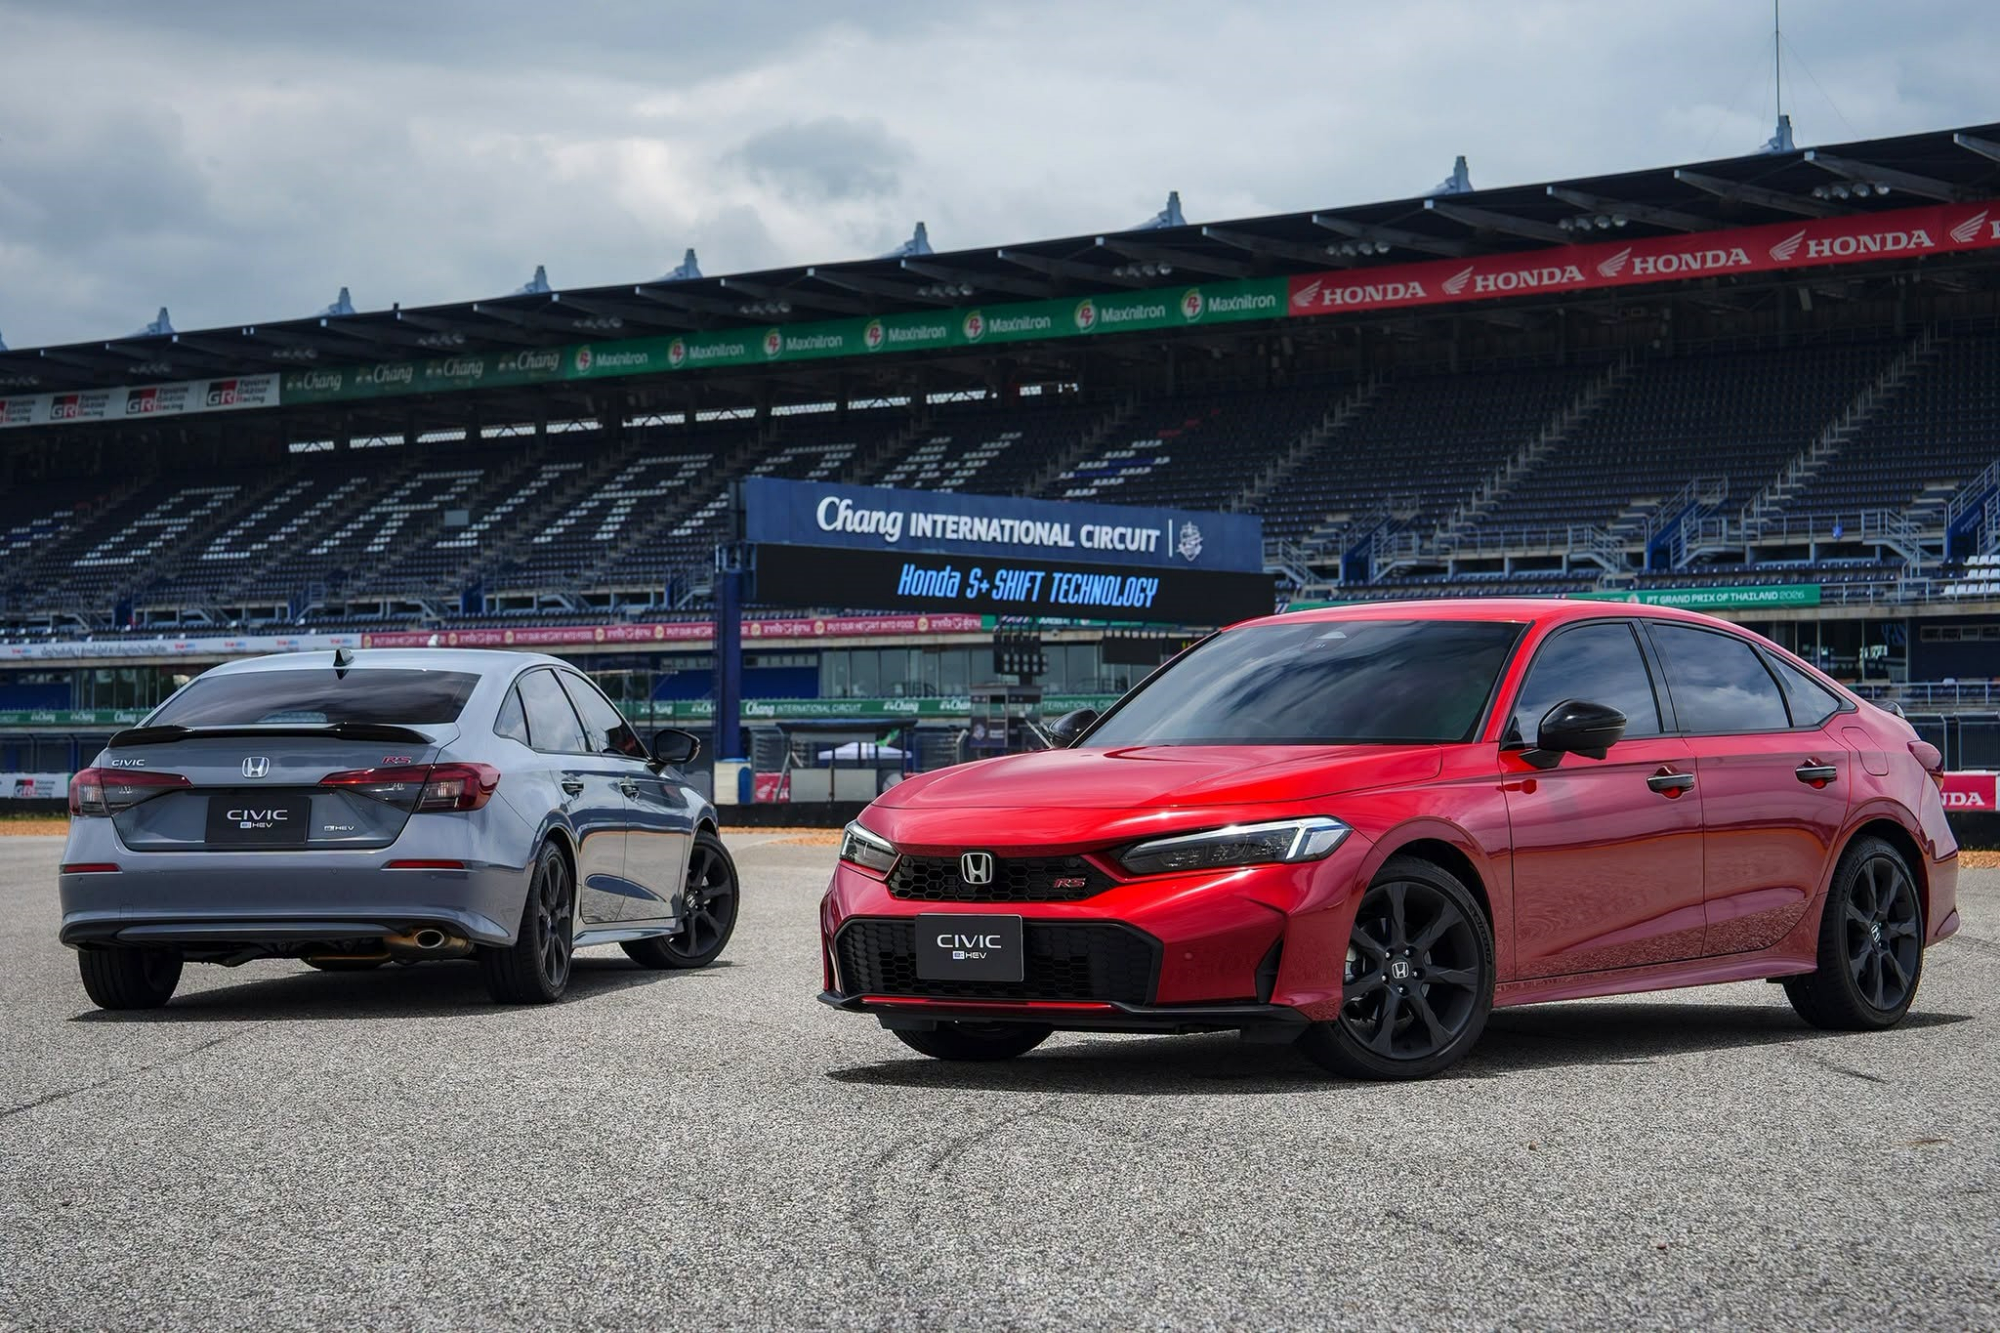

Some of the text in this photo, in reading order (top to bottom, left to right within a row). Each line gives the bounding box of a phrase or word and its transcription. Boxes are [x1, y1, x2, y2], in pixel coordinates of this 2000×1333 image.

[1806, 229, 1935, 258] HONDA
[1632, 247, 1751, 276] HONDA
[1474, 264, 1585, 293] HONDA
[1208, 293, 1275, 312] Maxnitron
[1321, 281, 1427, 305] HONDA
[1102, 304, 1165, 323] Maxnitron
[888, 326, 946, 342] Maxnitron
[989, 316, 1051, 333] Maxnitron
[786, 335, 843, 350] Maxnitron
[444, 358, 484, 379] Chang
[517, 350, 560, 371] Chang
[304, 371, 342, 391] Chang
[374, 363, 413, 384] Chang
[816, 496, 1161, 552] Chang INTERNATIONAL CIRCUIT
[897, 563, 961, 598] Honda
[1049, 572, 1159, 608] TECHNOLOGY
[1660, 594, 1690, 604] GRAND
[1691, 593, 1714, 603] PRIX
[1716, 593, 1728, 602] OF
[1730, 591, 1778, 602] THAILAND
[745, 700, 862, 717] Chang INTERNATIONAL CIRCUIT
[894, 700, 920, 713] Chang
[111, 758, 145, 767] CIVIC
[382, 755, 412, 766] RS
[226, 809, 288, 821] CIVIC
[1053, 876, 1087, 890] RS
[936, 934, 1002, 949] CIVIC
